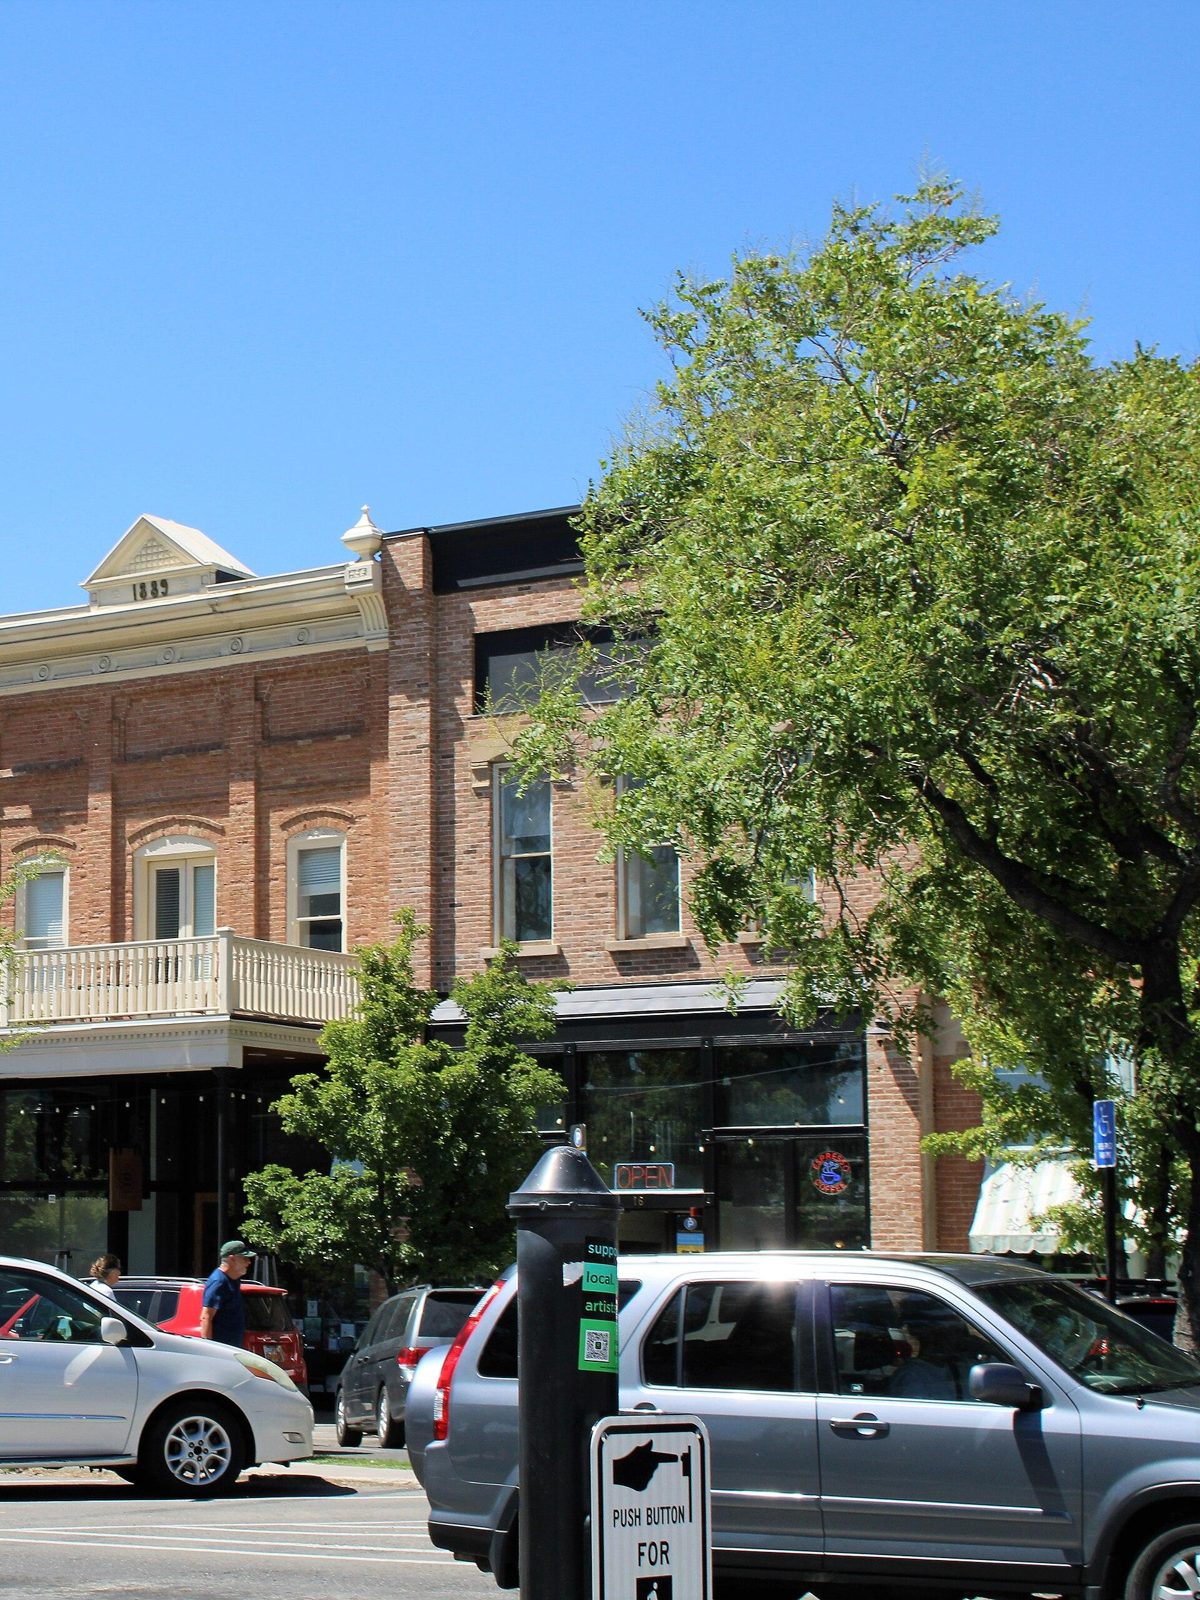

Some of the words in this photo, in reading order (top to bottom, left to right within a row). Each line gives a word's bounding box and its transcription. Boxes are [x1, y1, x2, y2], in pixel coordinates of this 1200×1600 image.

[133, 579, 168, 601] 1889
[812, 1152, 850, 1172] ESPRESSO
[617, 1166, 673, 1189] OPEN
[613, 1508, 641, 1528] PUSH
[646, 1505, 685, 1526] BUTTON
[637, 1541, 670, 1567] FOR
